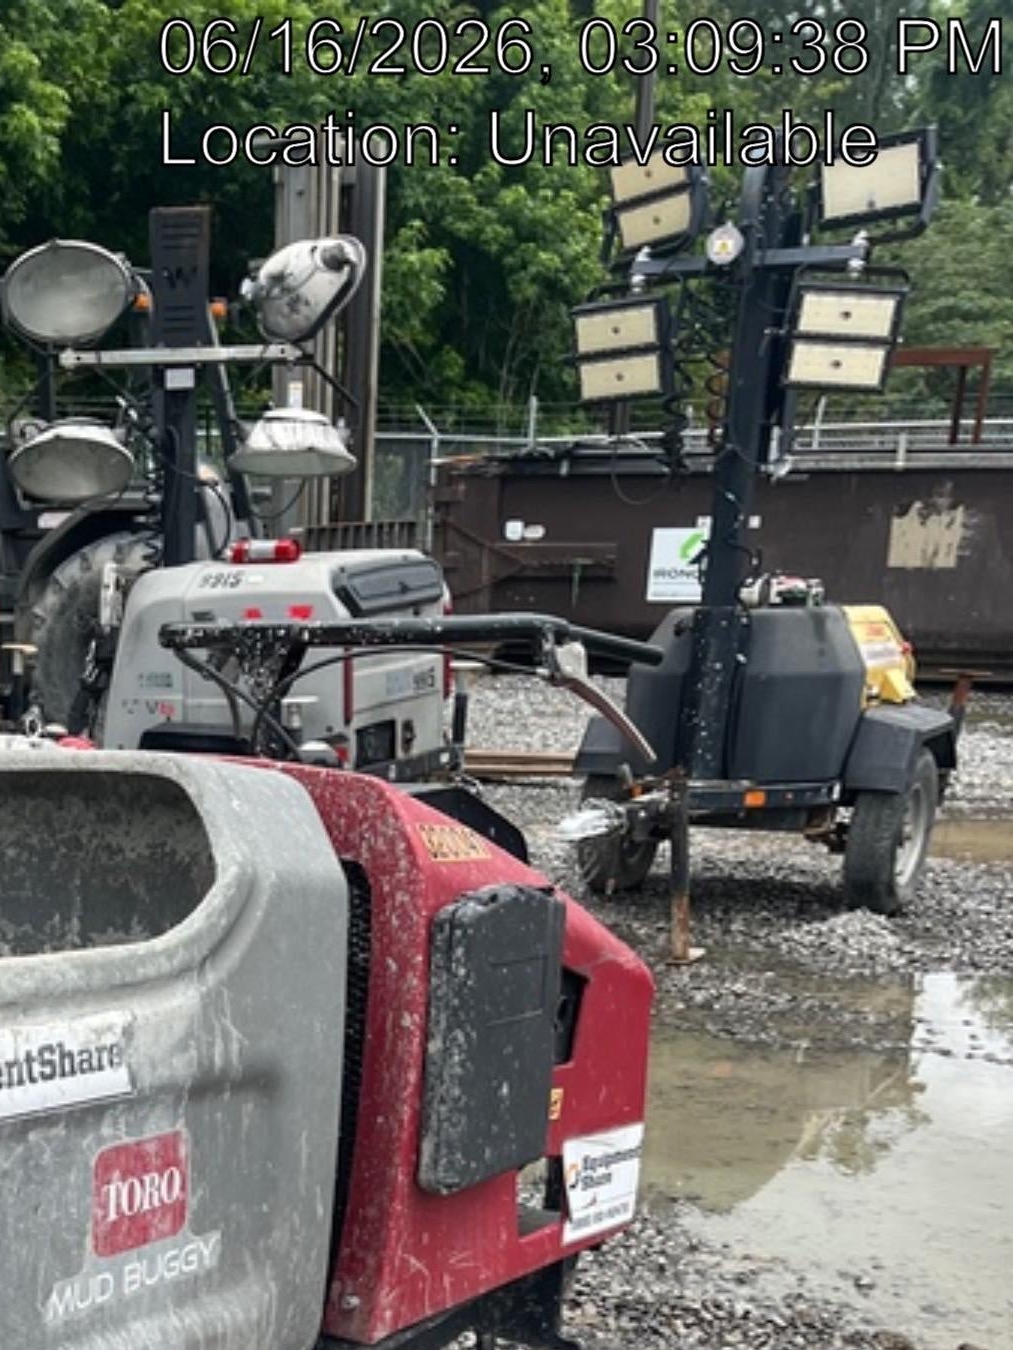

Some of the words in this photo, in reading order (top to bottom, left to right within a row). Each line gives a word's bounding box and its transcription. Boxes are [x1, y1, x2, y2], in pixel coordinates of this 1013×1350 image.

[101, 1166, 185, 1222] TORO
[45, 1272, 116, 1320] MUD
[122, 1240, 220, 1295] BUGGY
